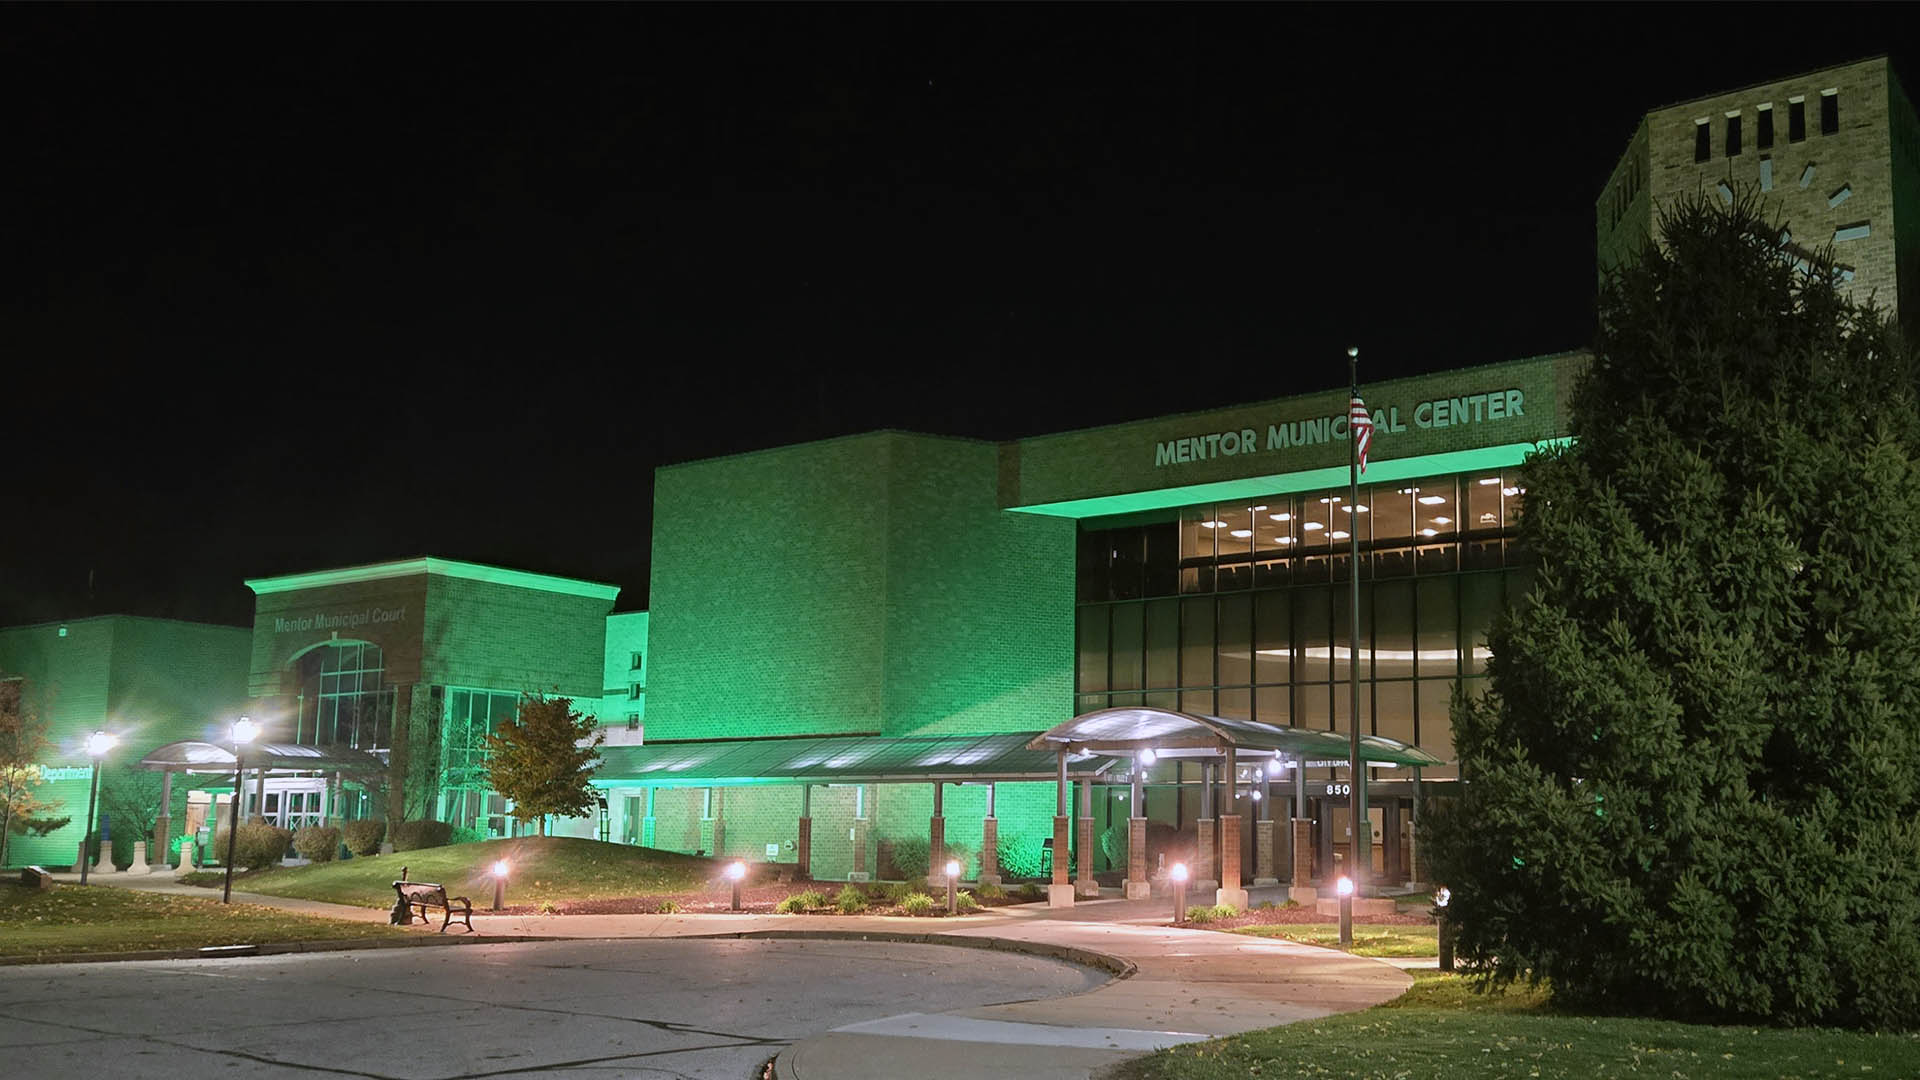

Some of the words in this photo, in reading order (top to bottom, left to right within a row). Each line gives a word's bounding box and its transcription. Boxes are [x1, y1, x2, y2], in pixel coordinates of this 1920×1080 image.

[1155, 432, 1256, 466] MENTOR
[1266, 407, 1407, 450] MUNICAL
[1413, 389, 1525, 430] CENTER
[274, 617, 312, 633] Mentor
[314, 608, 369, 630] Municipal
[372, 607, 406, 622] Court
